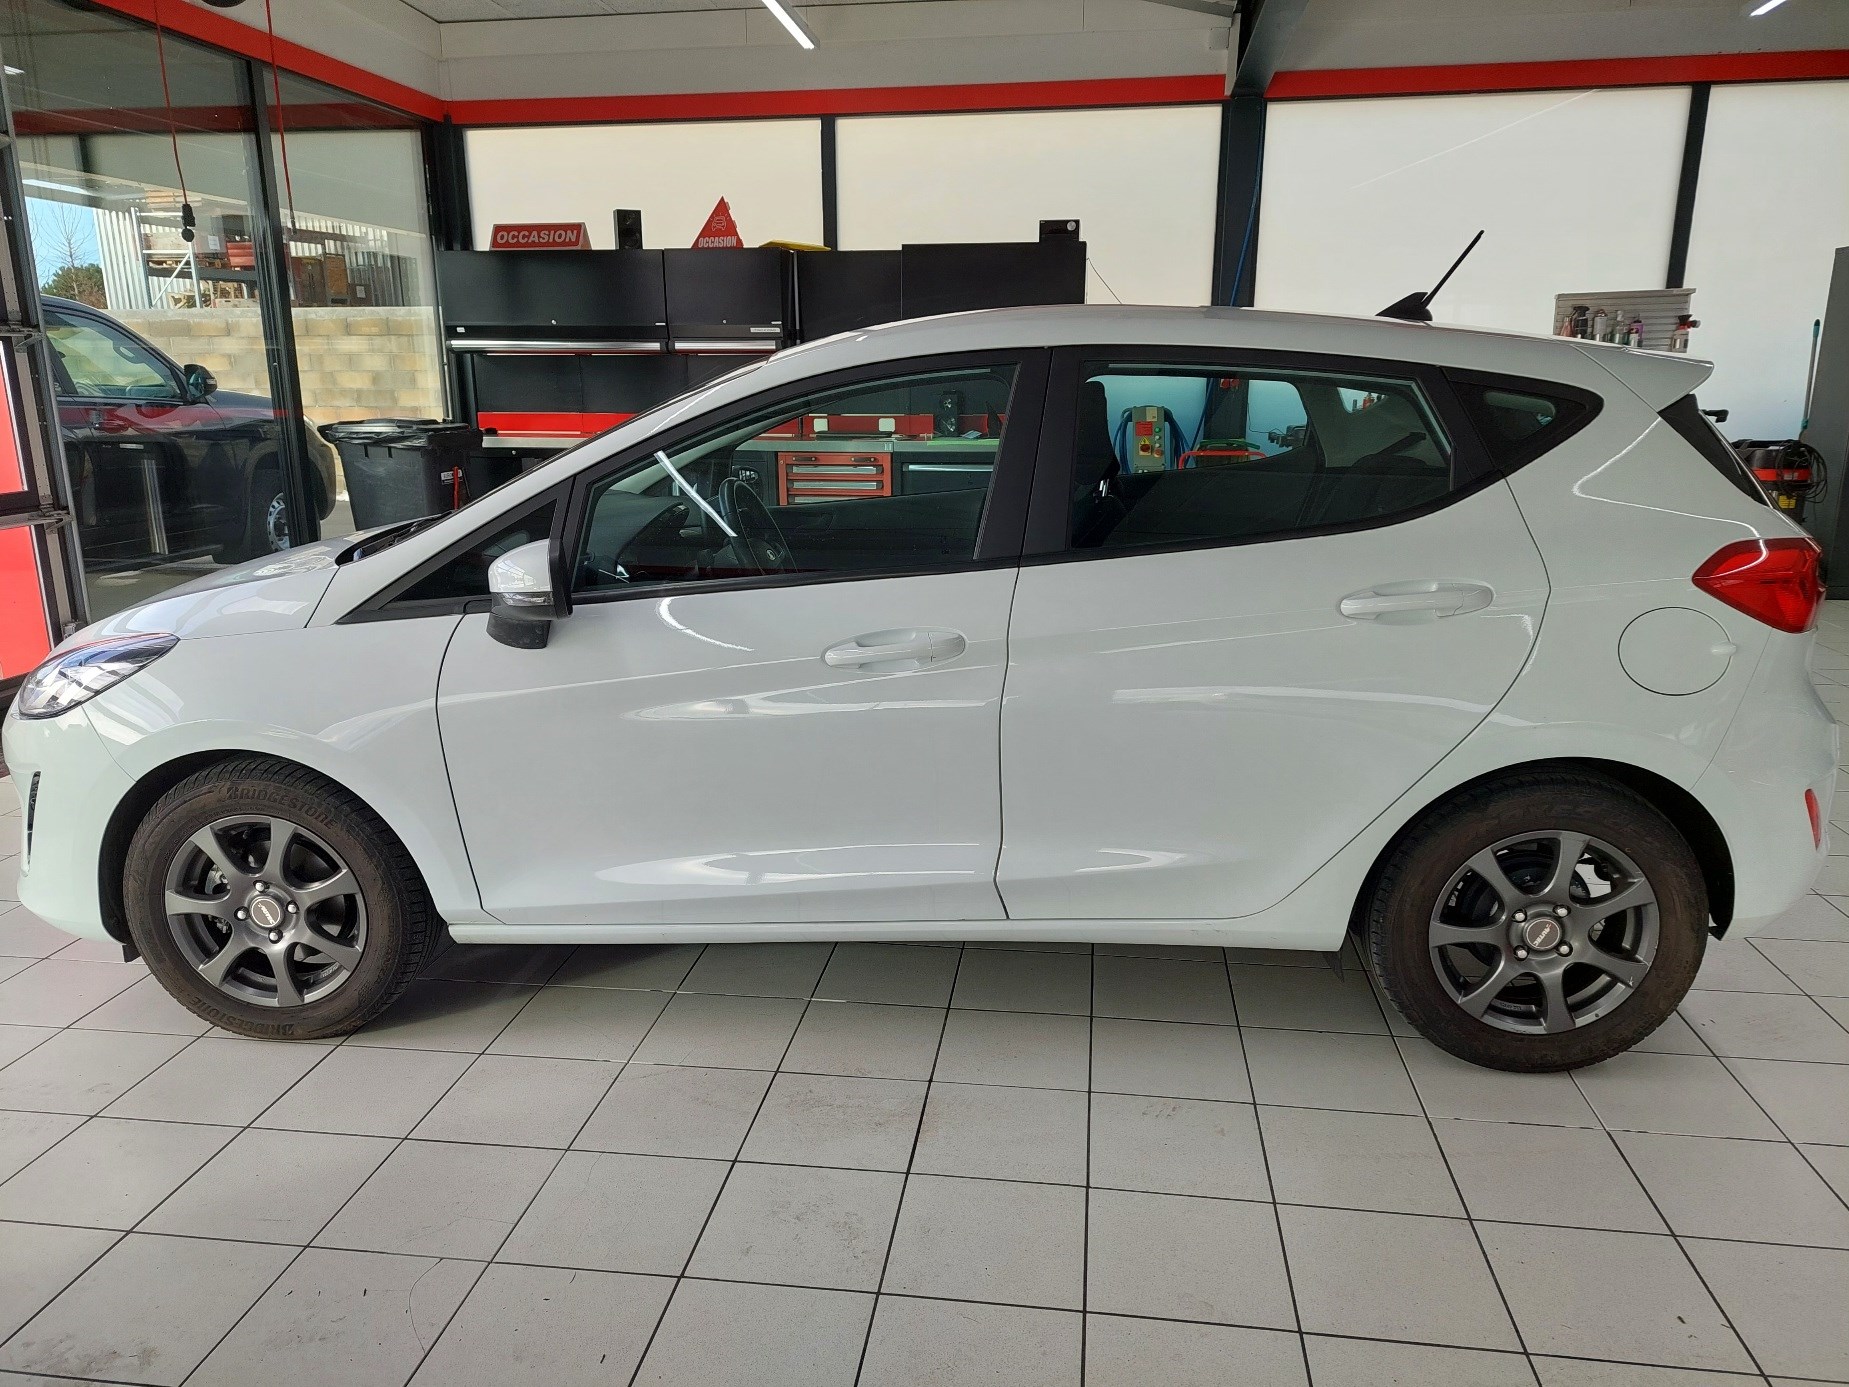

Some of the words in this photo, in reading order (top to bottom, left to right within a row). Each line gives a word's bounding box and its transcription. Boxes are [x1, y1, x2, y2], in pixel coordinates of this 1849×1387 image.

[496, 230, 578, 244] OCCASION
[698, 235, 737, 248] OCCASION
[226, 785, 337, 830] BRIDGESTONE
[1533, 924, 1552, 947] AUTEC
